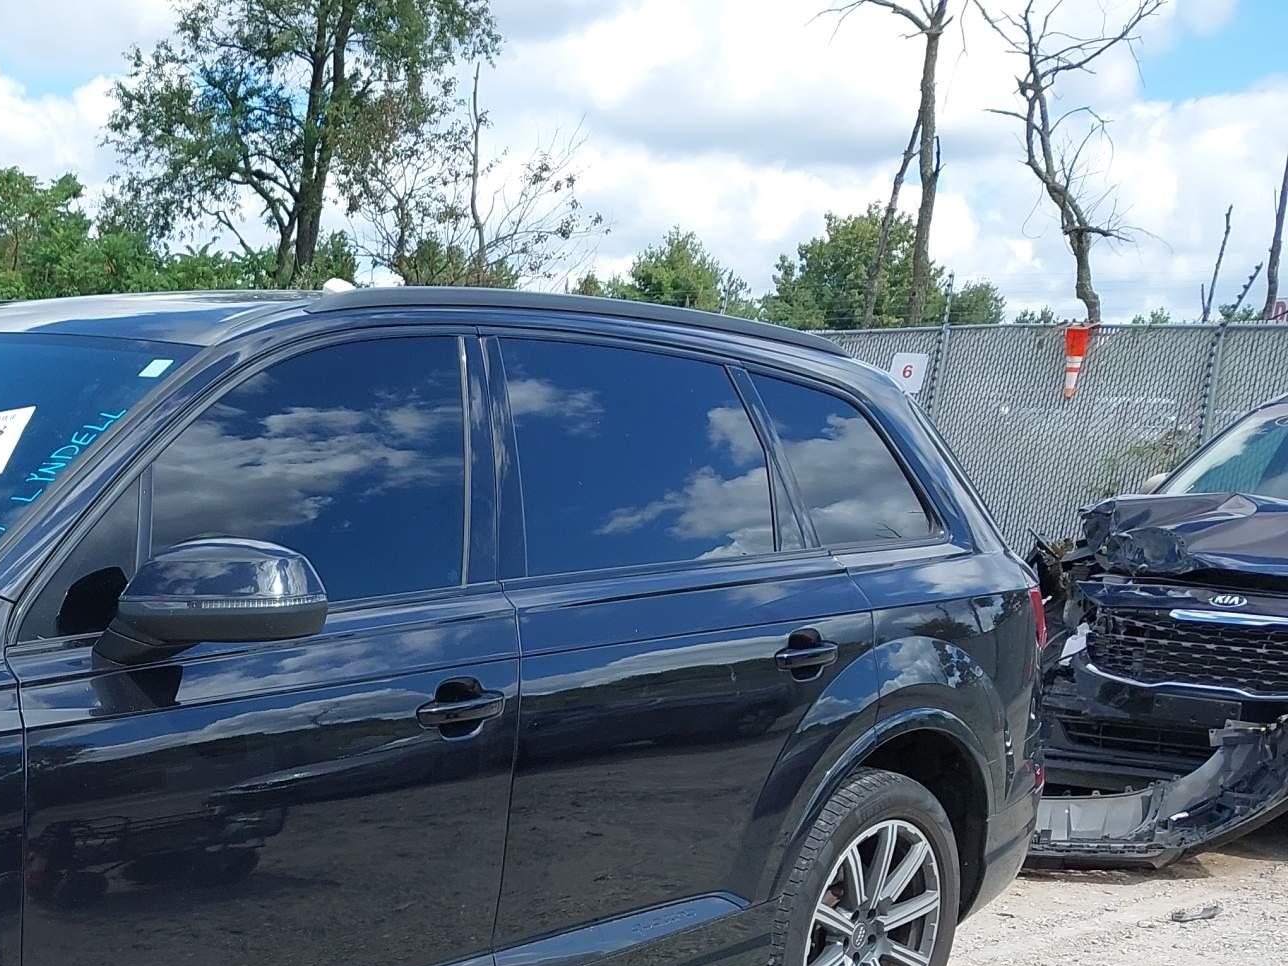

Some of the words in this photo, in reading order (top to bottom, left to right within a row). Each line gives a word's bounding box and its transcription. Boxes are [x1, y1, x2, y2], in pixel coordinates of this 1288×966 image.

[902, 364, 914, 379] 6
[11, 409, 127, 502] LYNDELL
[1214, 595, 1240, 605] KIA
